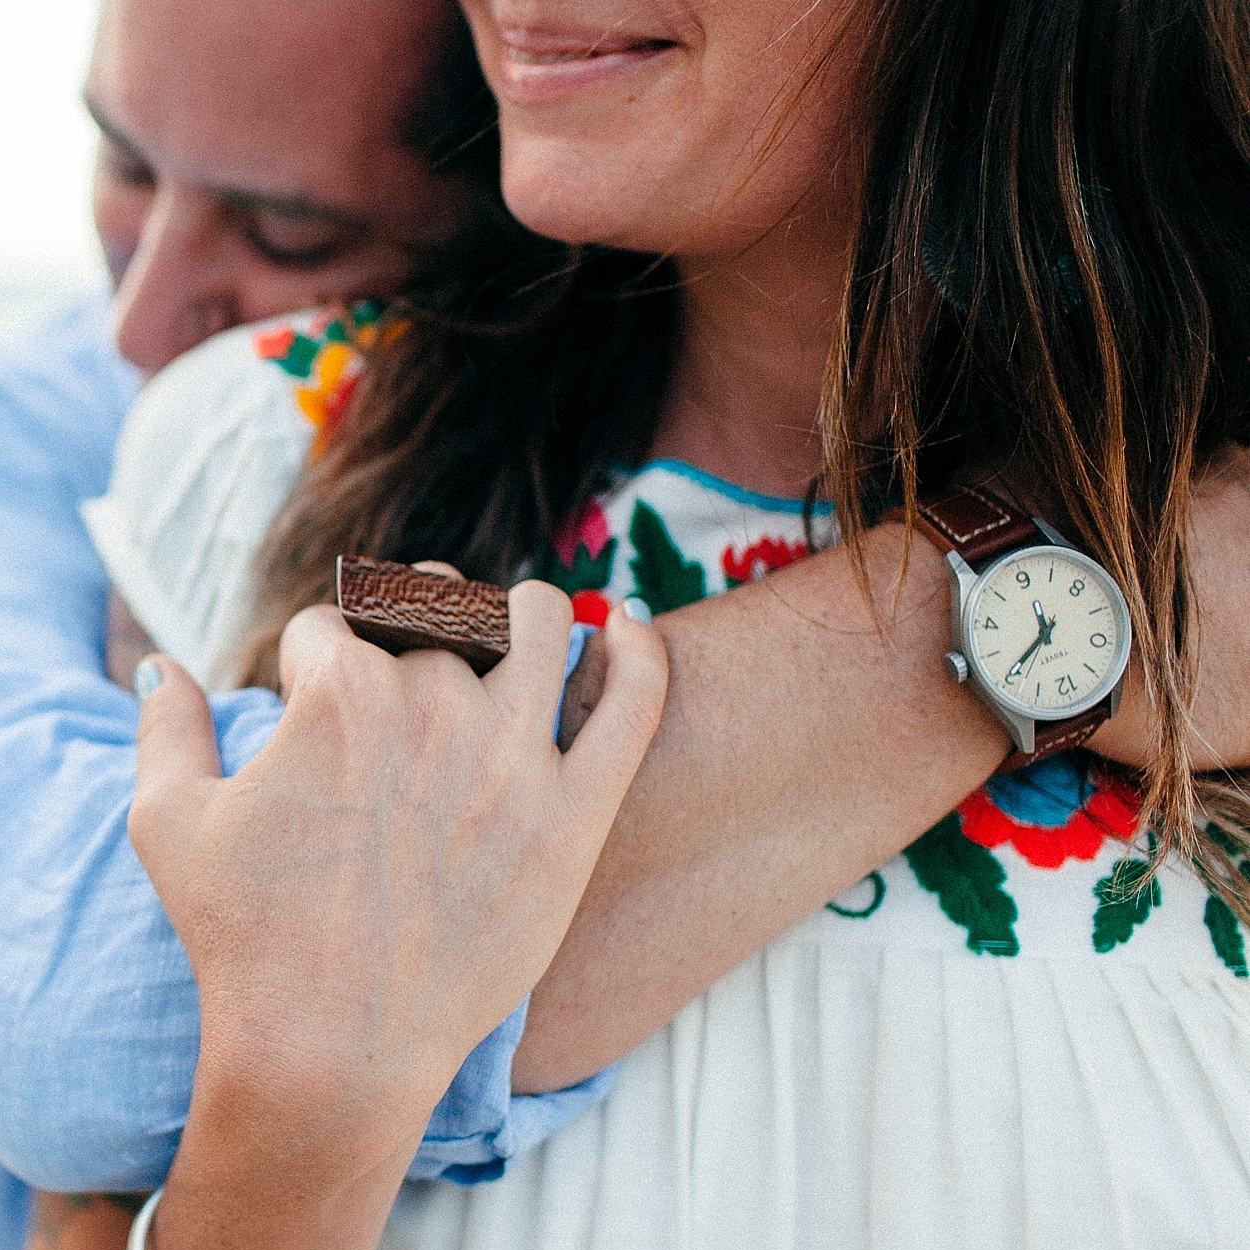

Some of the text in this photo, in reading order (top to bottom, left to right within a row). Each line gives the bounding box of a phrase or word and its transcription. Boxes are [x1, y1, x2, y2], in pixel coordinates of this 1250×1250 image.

[1016, 571, 1031, 589] 6
[1069, 579, 1085, 597] 8
[984, 617, 999, 632] 4
[1055, 674, 1078, 696] 12
